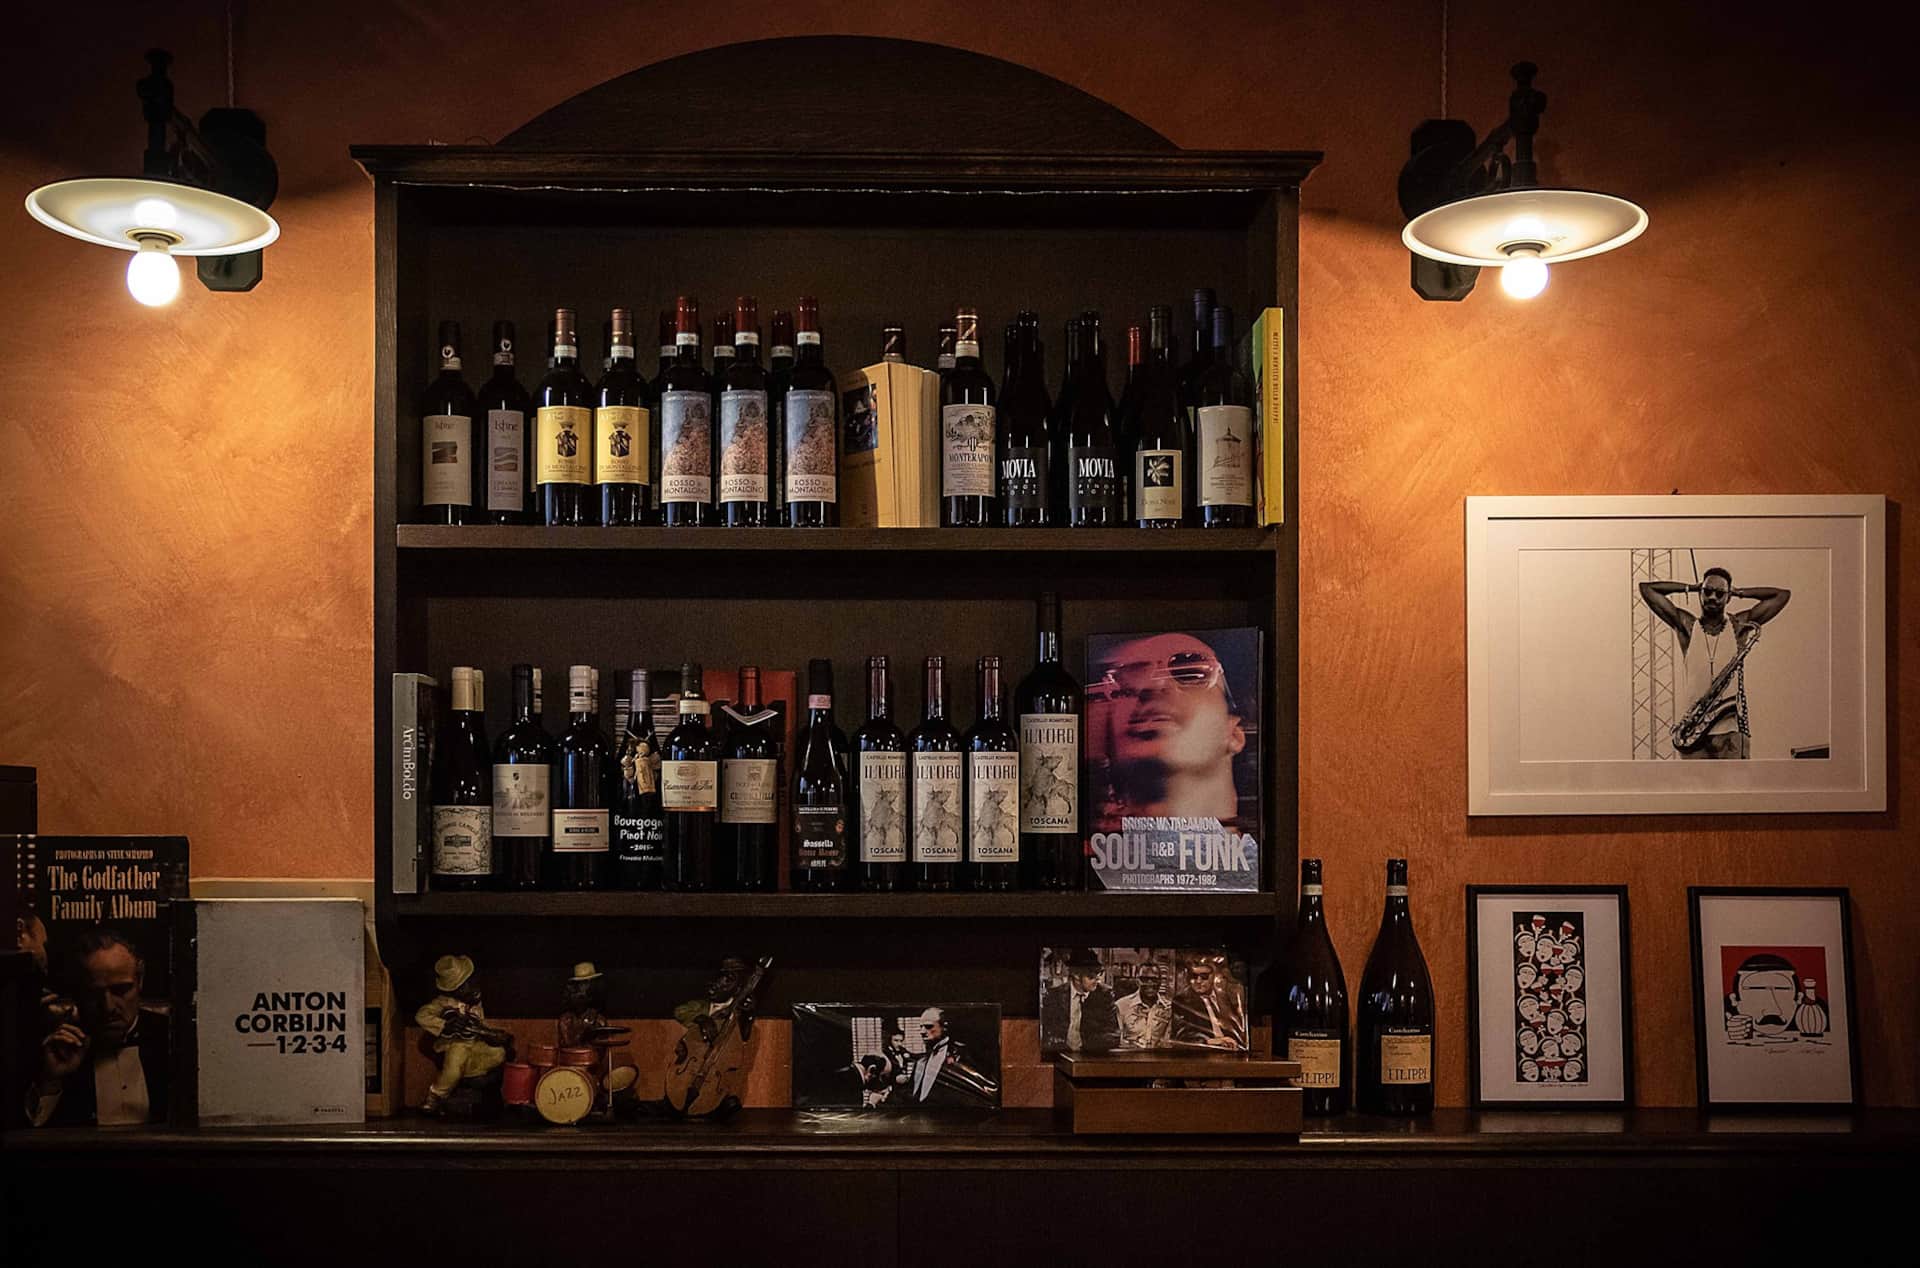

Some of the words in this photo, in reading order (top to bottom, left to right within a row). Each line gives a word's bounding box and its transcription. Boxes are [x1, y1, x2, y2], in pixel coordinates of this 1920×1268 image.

[1001, 459, 1037, 479] MOVIA
[1078, 458, 1116, 478] MOVIA
[614, 814, 664, 830] Bourgogn
[1029, 817, 1070, 825] TOSCANA
[620, 829, 645, 840] Pinot
[1090, 832, 1155, 871] SOUL
[1151, 841, 1175, 857] R&B
[1179, 831, 1250, 872] FUNK
[47, 865, 79, 891] The
[81, 864, 160, 891] Godfather
[1122, 873, 1175, 886] PHOTOGRAPHS
[1176, 873, 1217, 886] 1972-1982
[50, 894, 104, 925] Family
[107, 893, 158, 920] Album
[252, 991, 346, 1011] ANTON
[235, 1013, 346, 1034] CORBIJN
